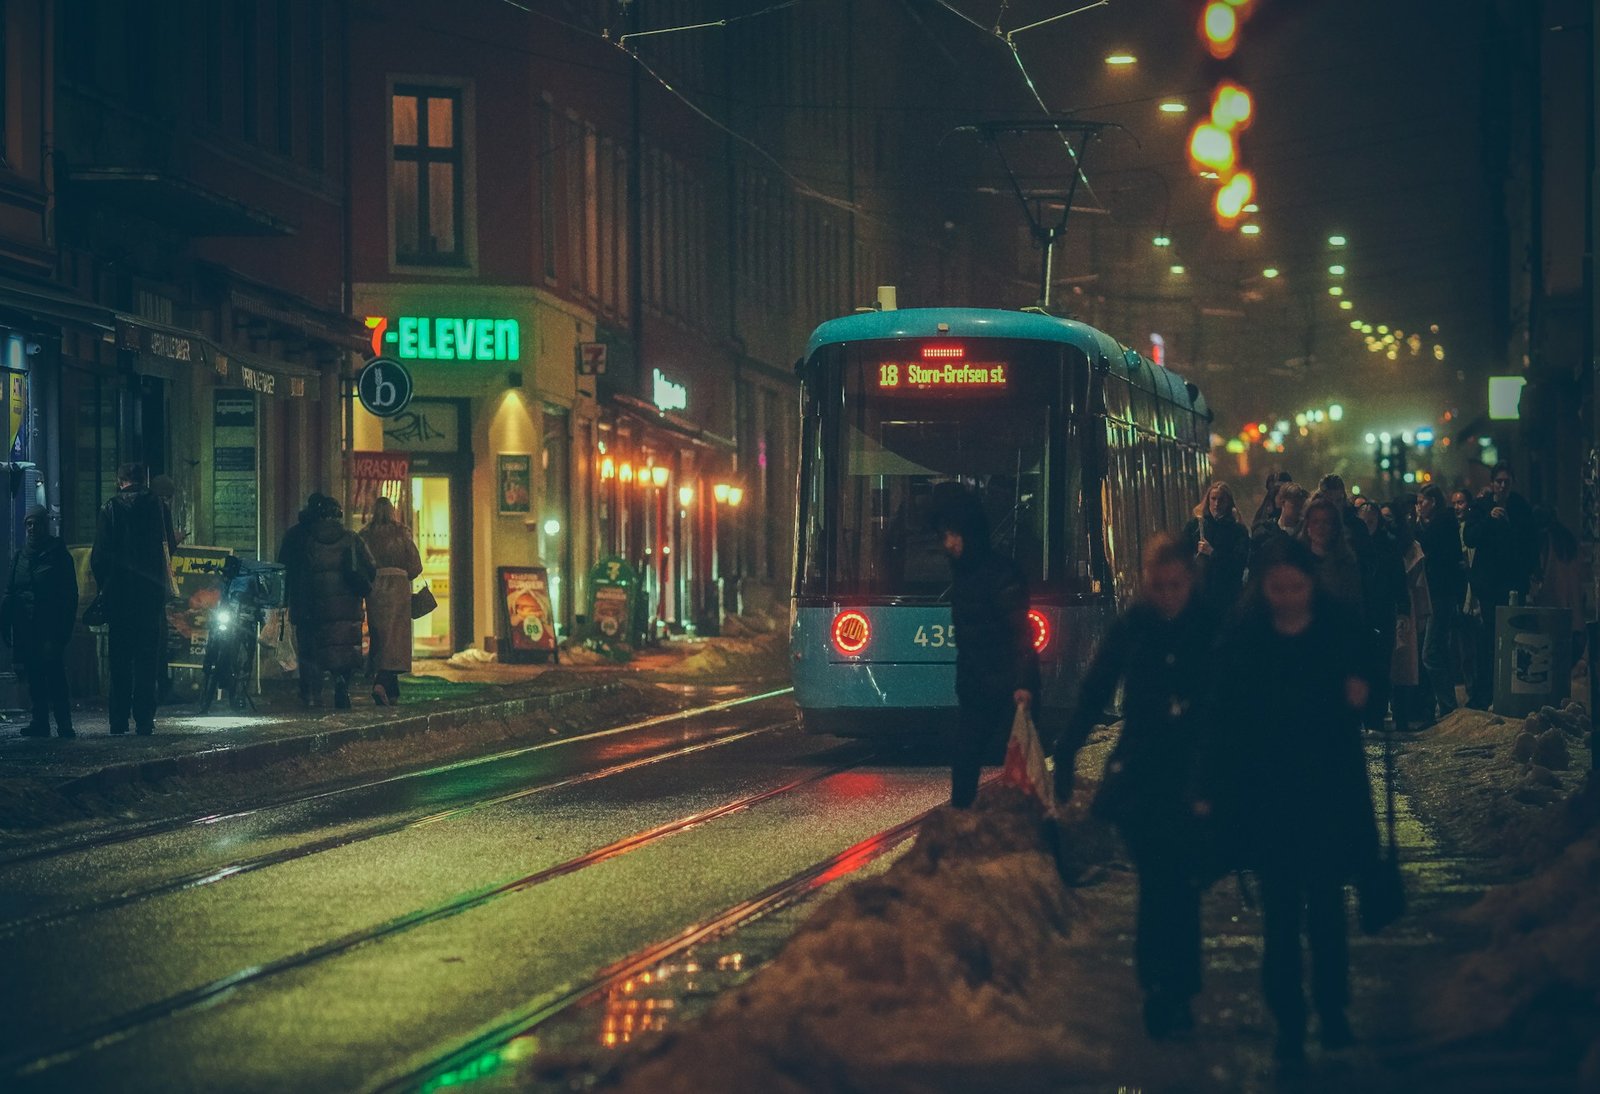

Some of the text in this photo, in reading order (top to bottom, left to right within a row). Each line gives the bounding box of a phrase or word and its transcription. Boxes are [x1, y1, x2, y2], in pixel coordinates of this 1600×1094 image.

[364, 316, 520, 361] 7-ELEVEN
[879, 364, 1007, 386] 18 Storo-Grefsen st.
[914, 624, 957, 648] 435
